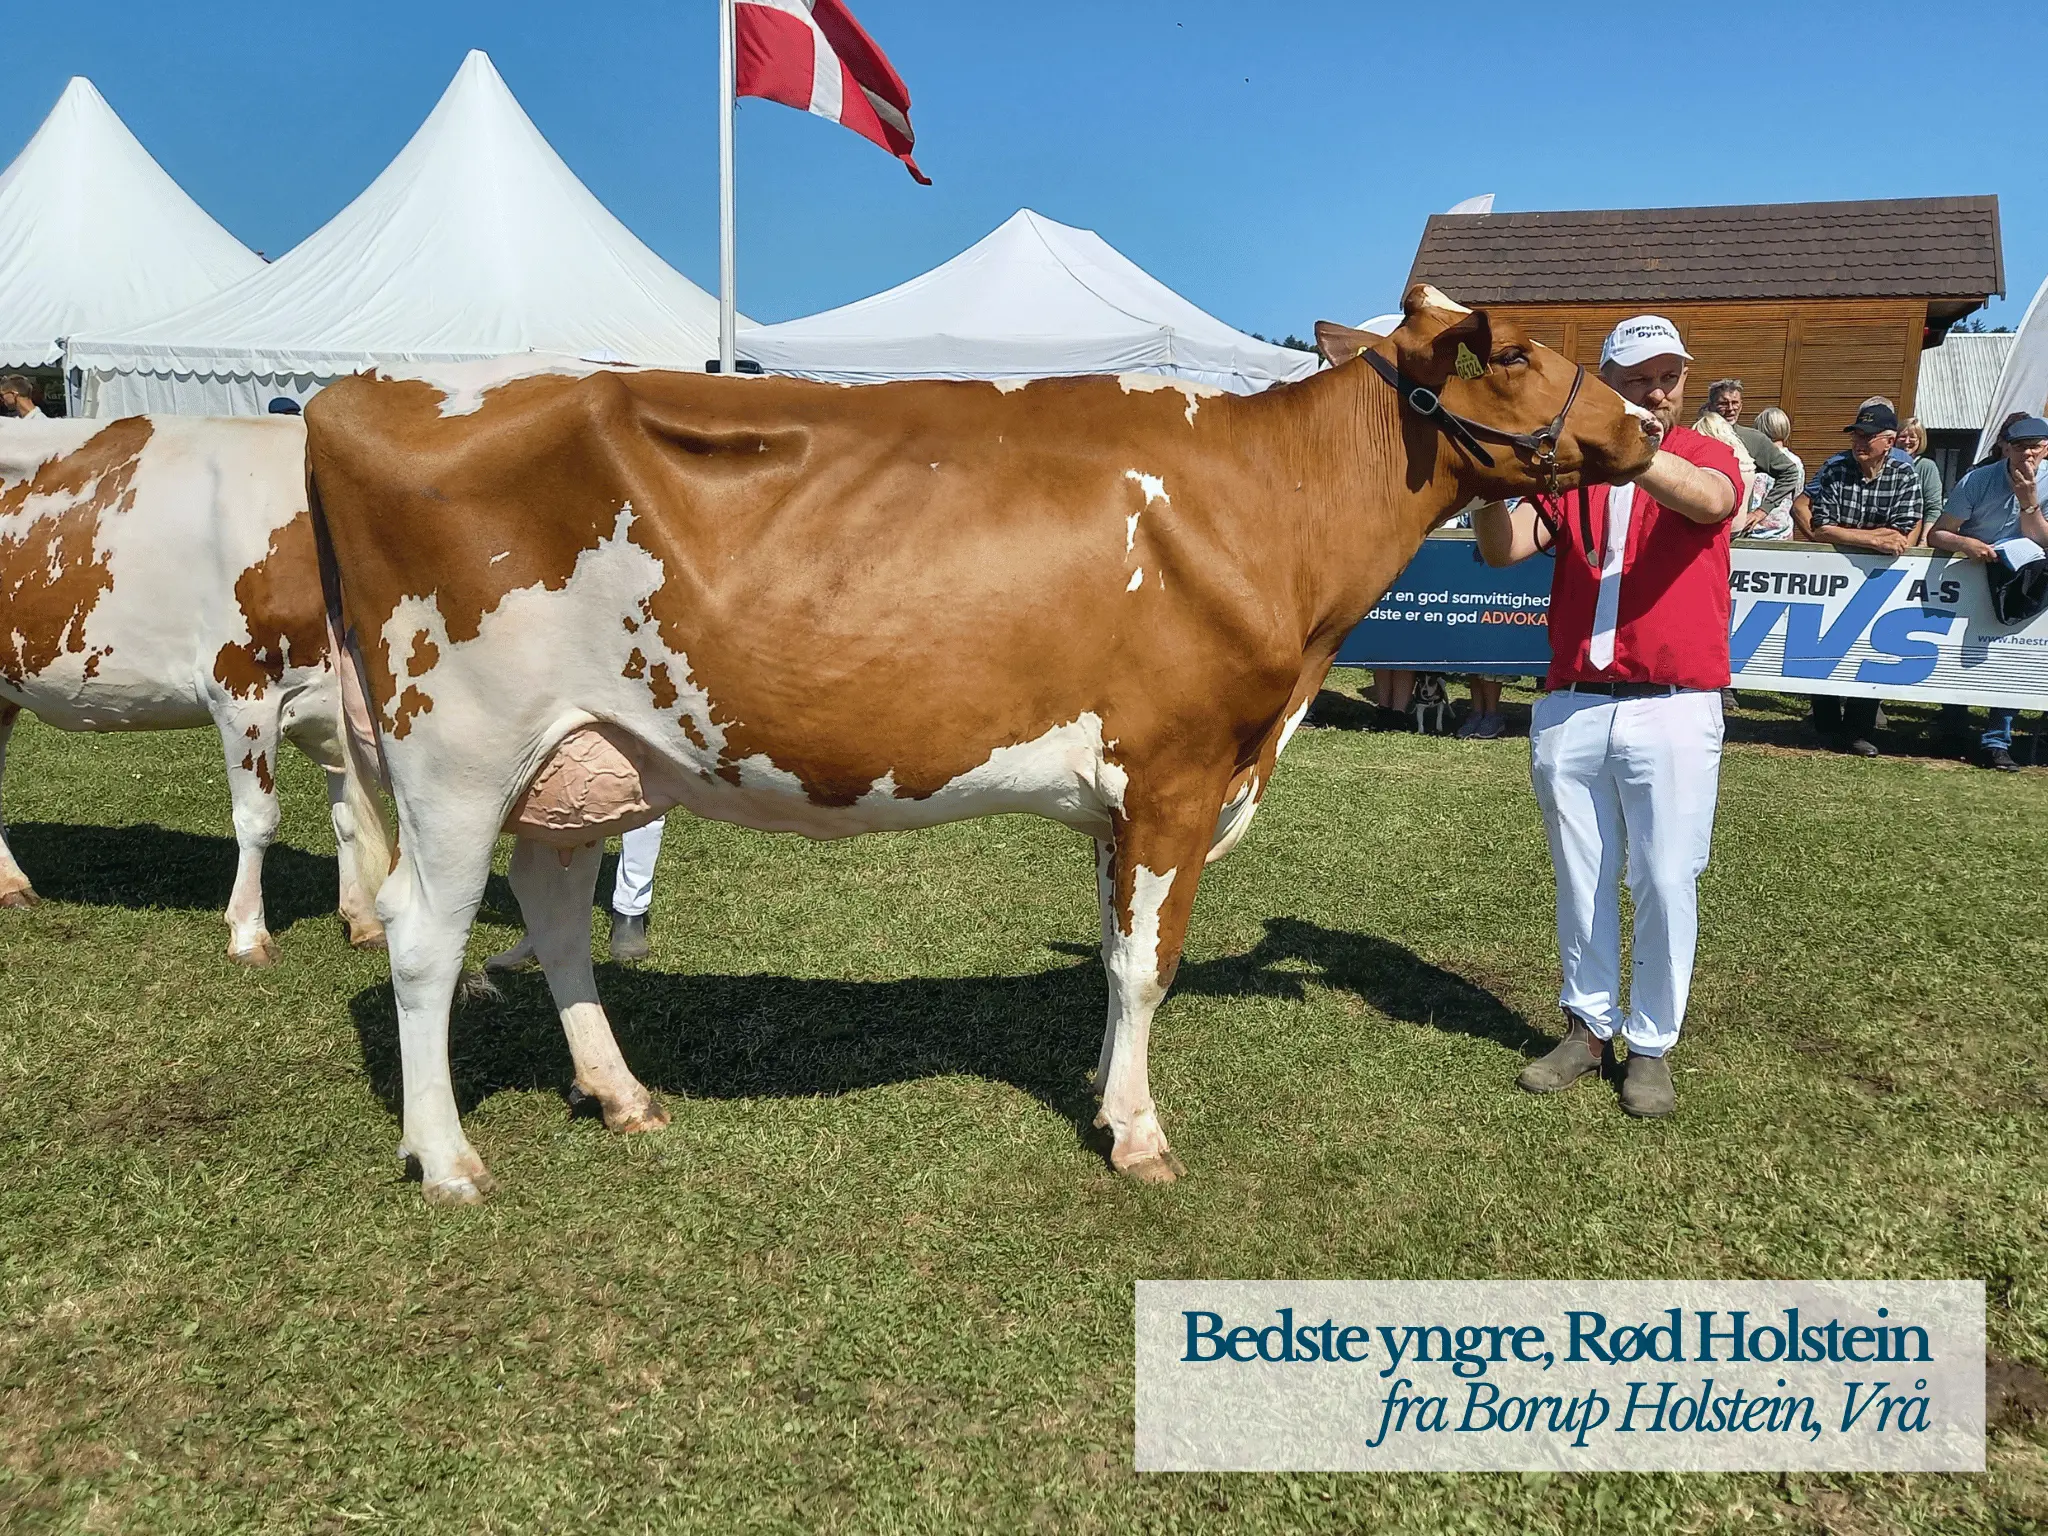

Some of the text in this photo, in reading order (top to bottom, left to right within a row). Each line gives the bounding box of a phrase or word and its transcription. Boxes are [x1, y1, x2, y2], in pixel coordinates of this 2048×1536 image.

[1458, 360, 1484, 380] 04124
[1395, 592, 1414, 602] en
[1418, 591, 1448, 606] god
[1452, 592, 1551, 609] samvittighed
[1906, 579, 1961, 603] A-S
[1405, 611, 1421, 620] er
[1424, 612, 1443, 622] en
[1447, 610, 1477, 626] god
[1481, 611, 1549, 626] ADVOKA
